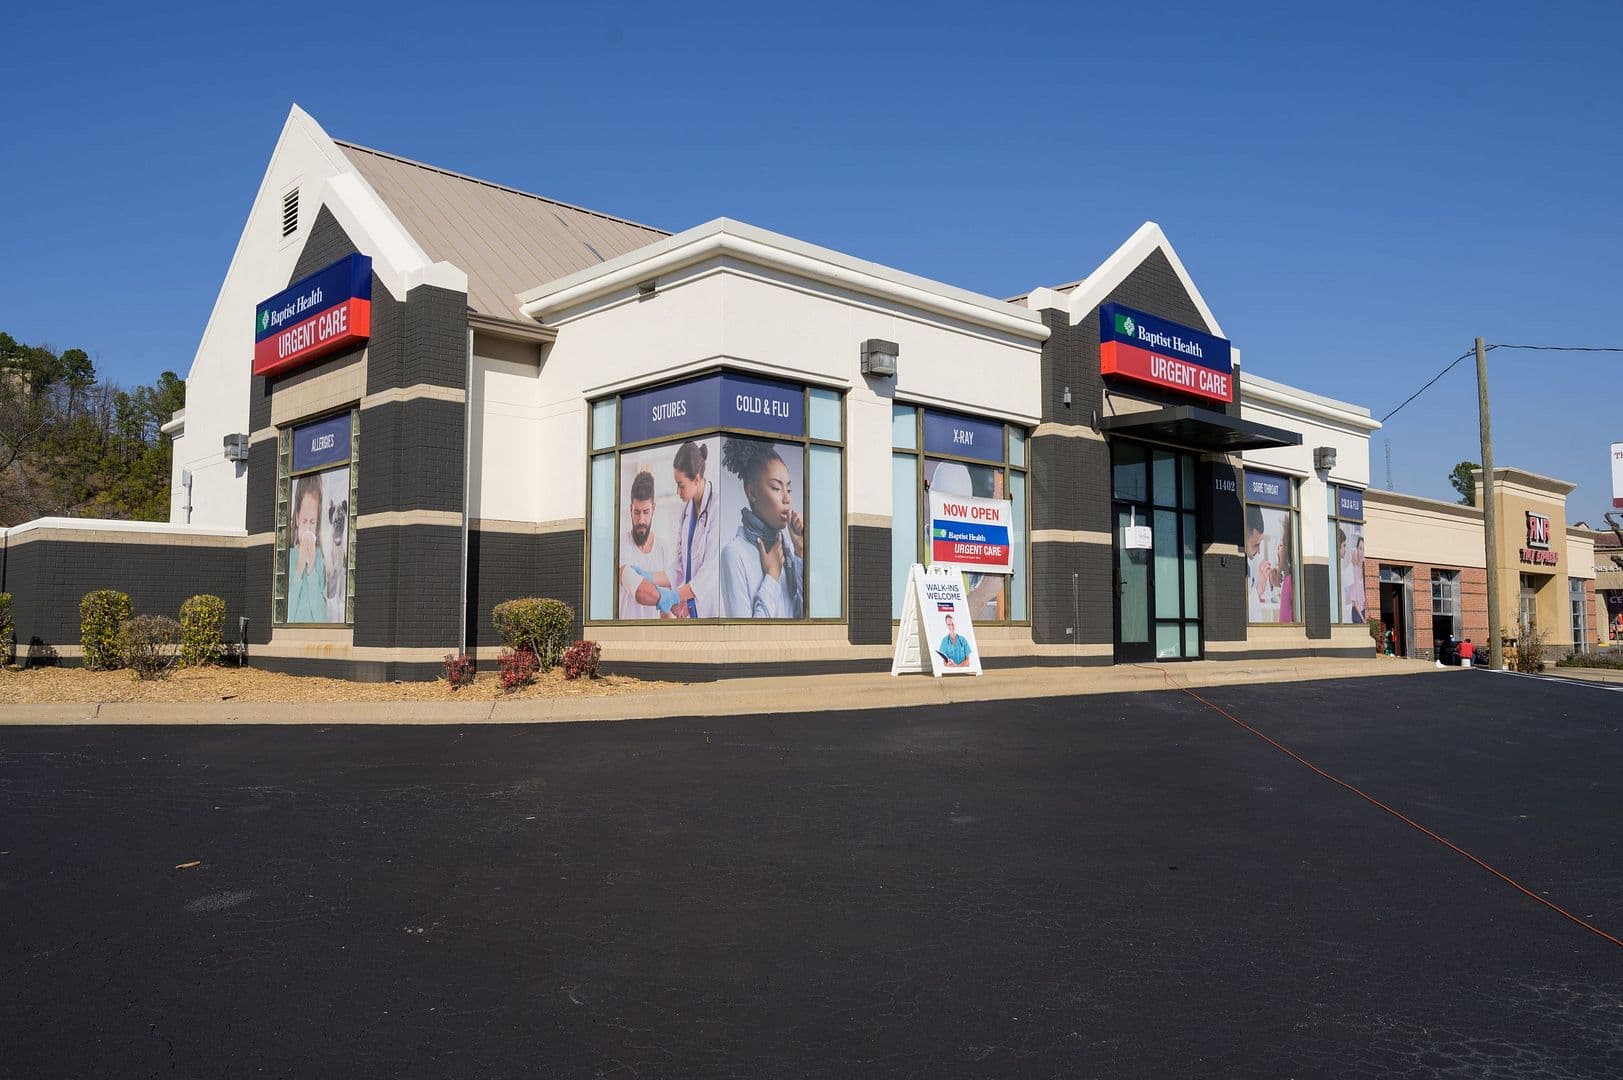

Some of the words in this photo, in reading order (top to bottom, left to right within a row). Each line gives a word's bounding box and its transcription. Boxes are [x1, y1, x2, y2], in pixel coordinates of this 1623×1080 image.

[271, 303, 296, 327] Baptist
[296, 287, 323, 314] Health
[278, 320, 316, 358] URGENT
[318, 306, 347, 341] CARE
[1137, 325, 1171, 347] Baptist
[1172, 336, 1203, 358] Health
[1150, 356, 1196, 387] URGENT
[1199, 370, 1227, 396] CARE
[652, 400, 687, 422] SUTURES
[736, 395, 761, 414] COLD
[763, 399, 771, 415] &
[772, 400, 789, 418] FLU
[311, 433, 335, 452] ALLERGIES
[953, 428, 974, 446] X-RAY
[1215, 479, 1235, 492] 11402
[1252, 481, 1264, 493] SORE
[943, 503, 968, 518] NOW
[971, 506, 999, 521] OPEN
[948, 531, 968, 541] Baptist
[968, 534, 986, 542] Health
[954, 543, 983, 555] URGENT
[983, 546, 1002, 557] CARE
[926, 584, 959, 592] WALK-INS
[927, 592, 961, 600] WELCOME
